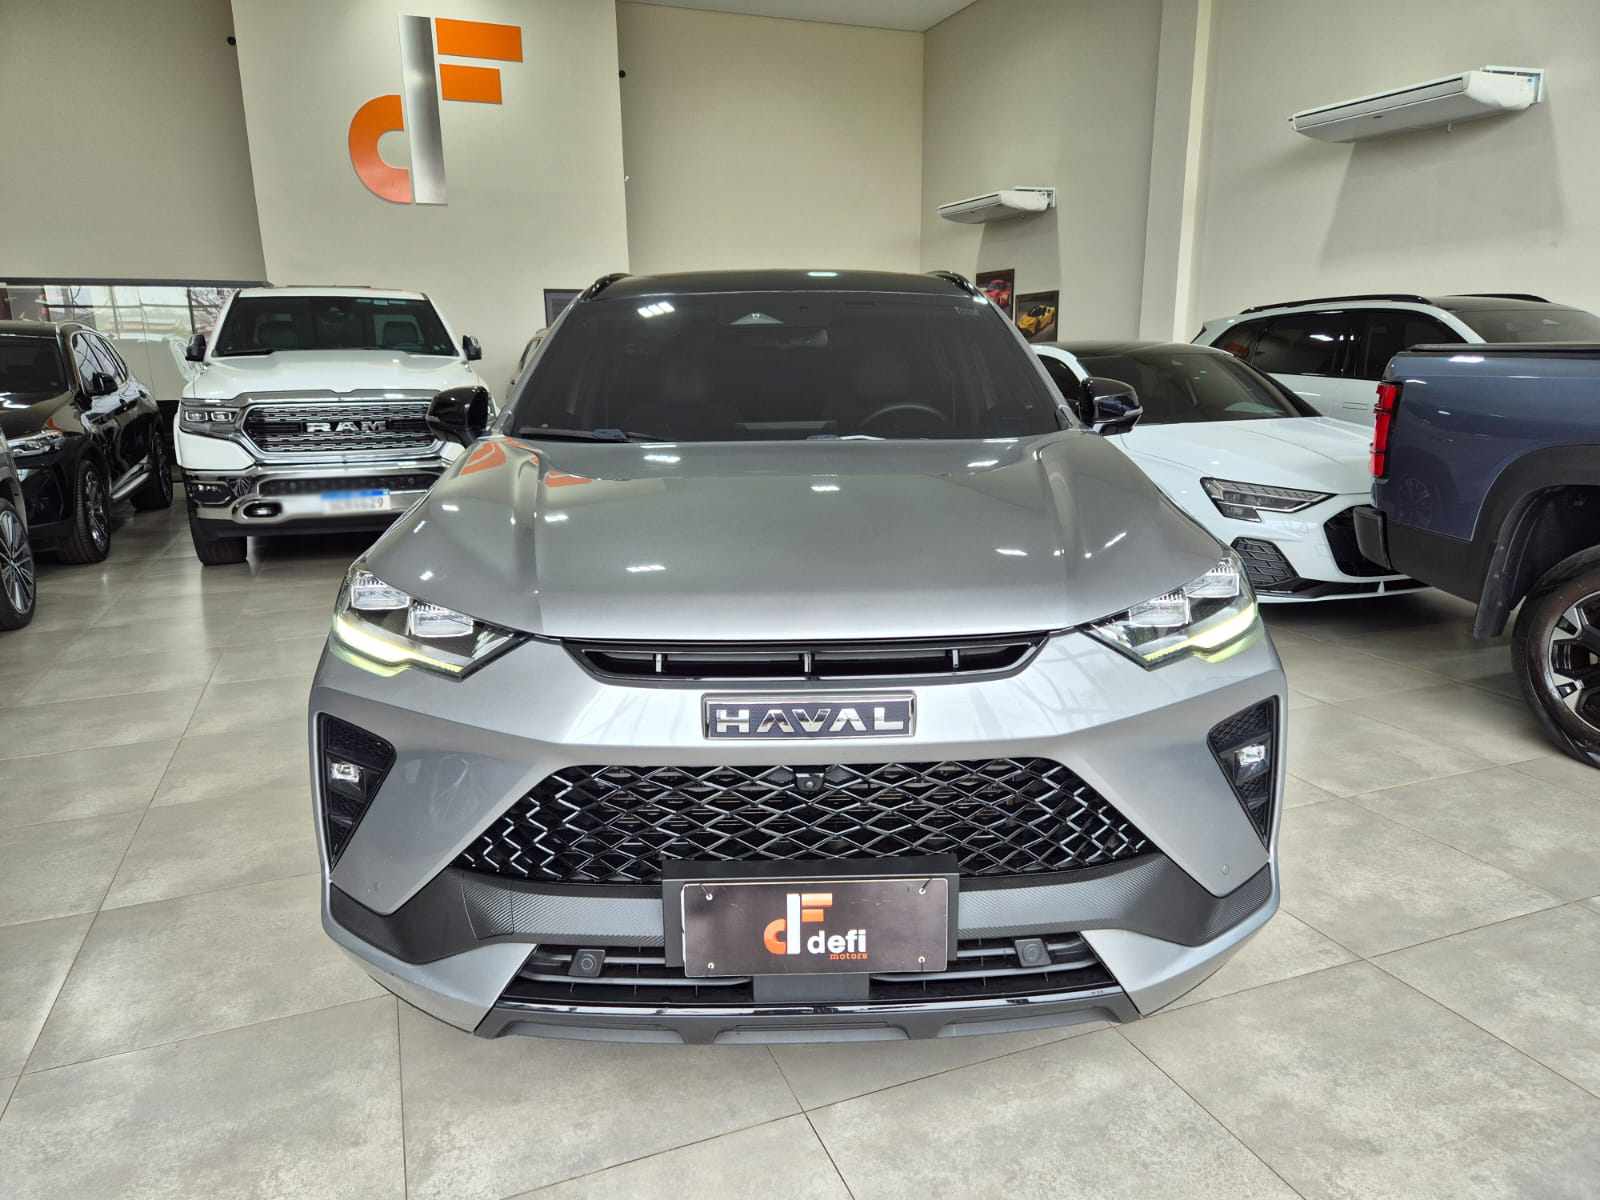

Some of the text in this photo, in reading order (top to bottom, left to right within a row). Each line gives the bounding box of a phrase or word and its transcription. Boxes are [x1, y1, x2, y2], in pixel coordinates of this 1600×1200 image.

[306, 420, 386, 433] RAM
[716, 707, 904, 733] HAVAL
[807, 929, 867, 954] defi
[829, 953, 869, 961] motors
